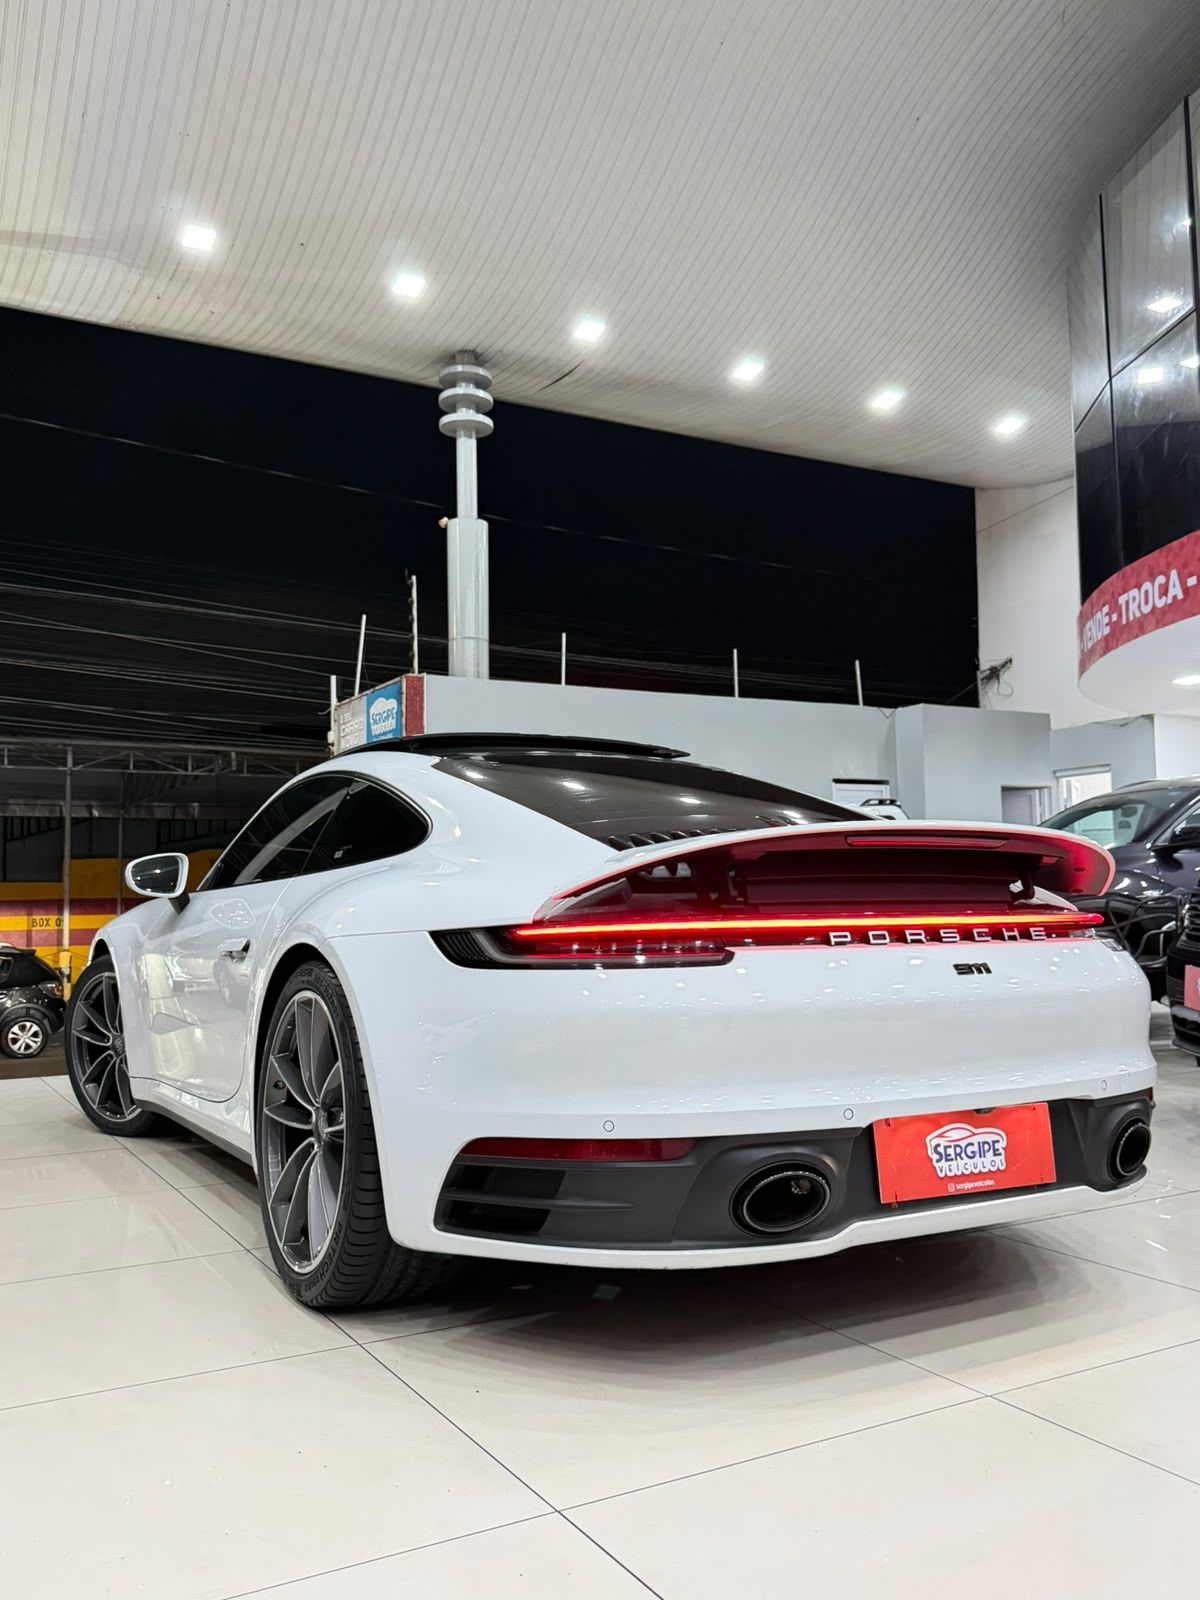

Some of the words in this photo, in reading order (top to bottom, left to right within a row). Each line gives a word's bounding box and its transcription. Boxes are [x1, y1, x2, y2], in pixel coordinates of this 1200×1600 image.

[1118, 568, 1184, 625] TROCA
[372, 706, 396, 725] SERGIPE
[31, 917, 51, 928] BOX
[829, 927, 1047, 946] PORSCHE
[952, 962, 993, 976] 911
[933, 1139, 1002, 1163] SERGIPE
